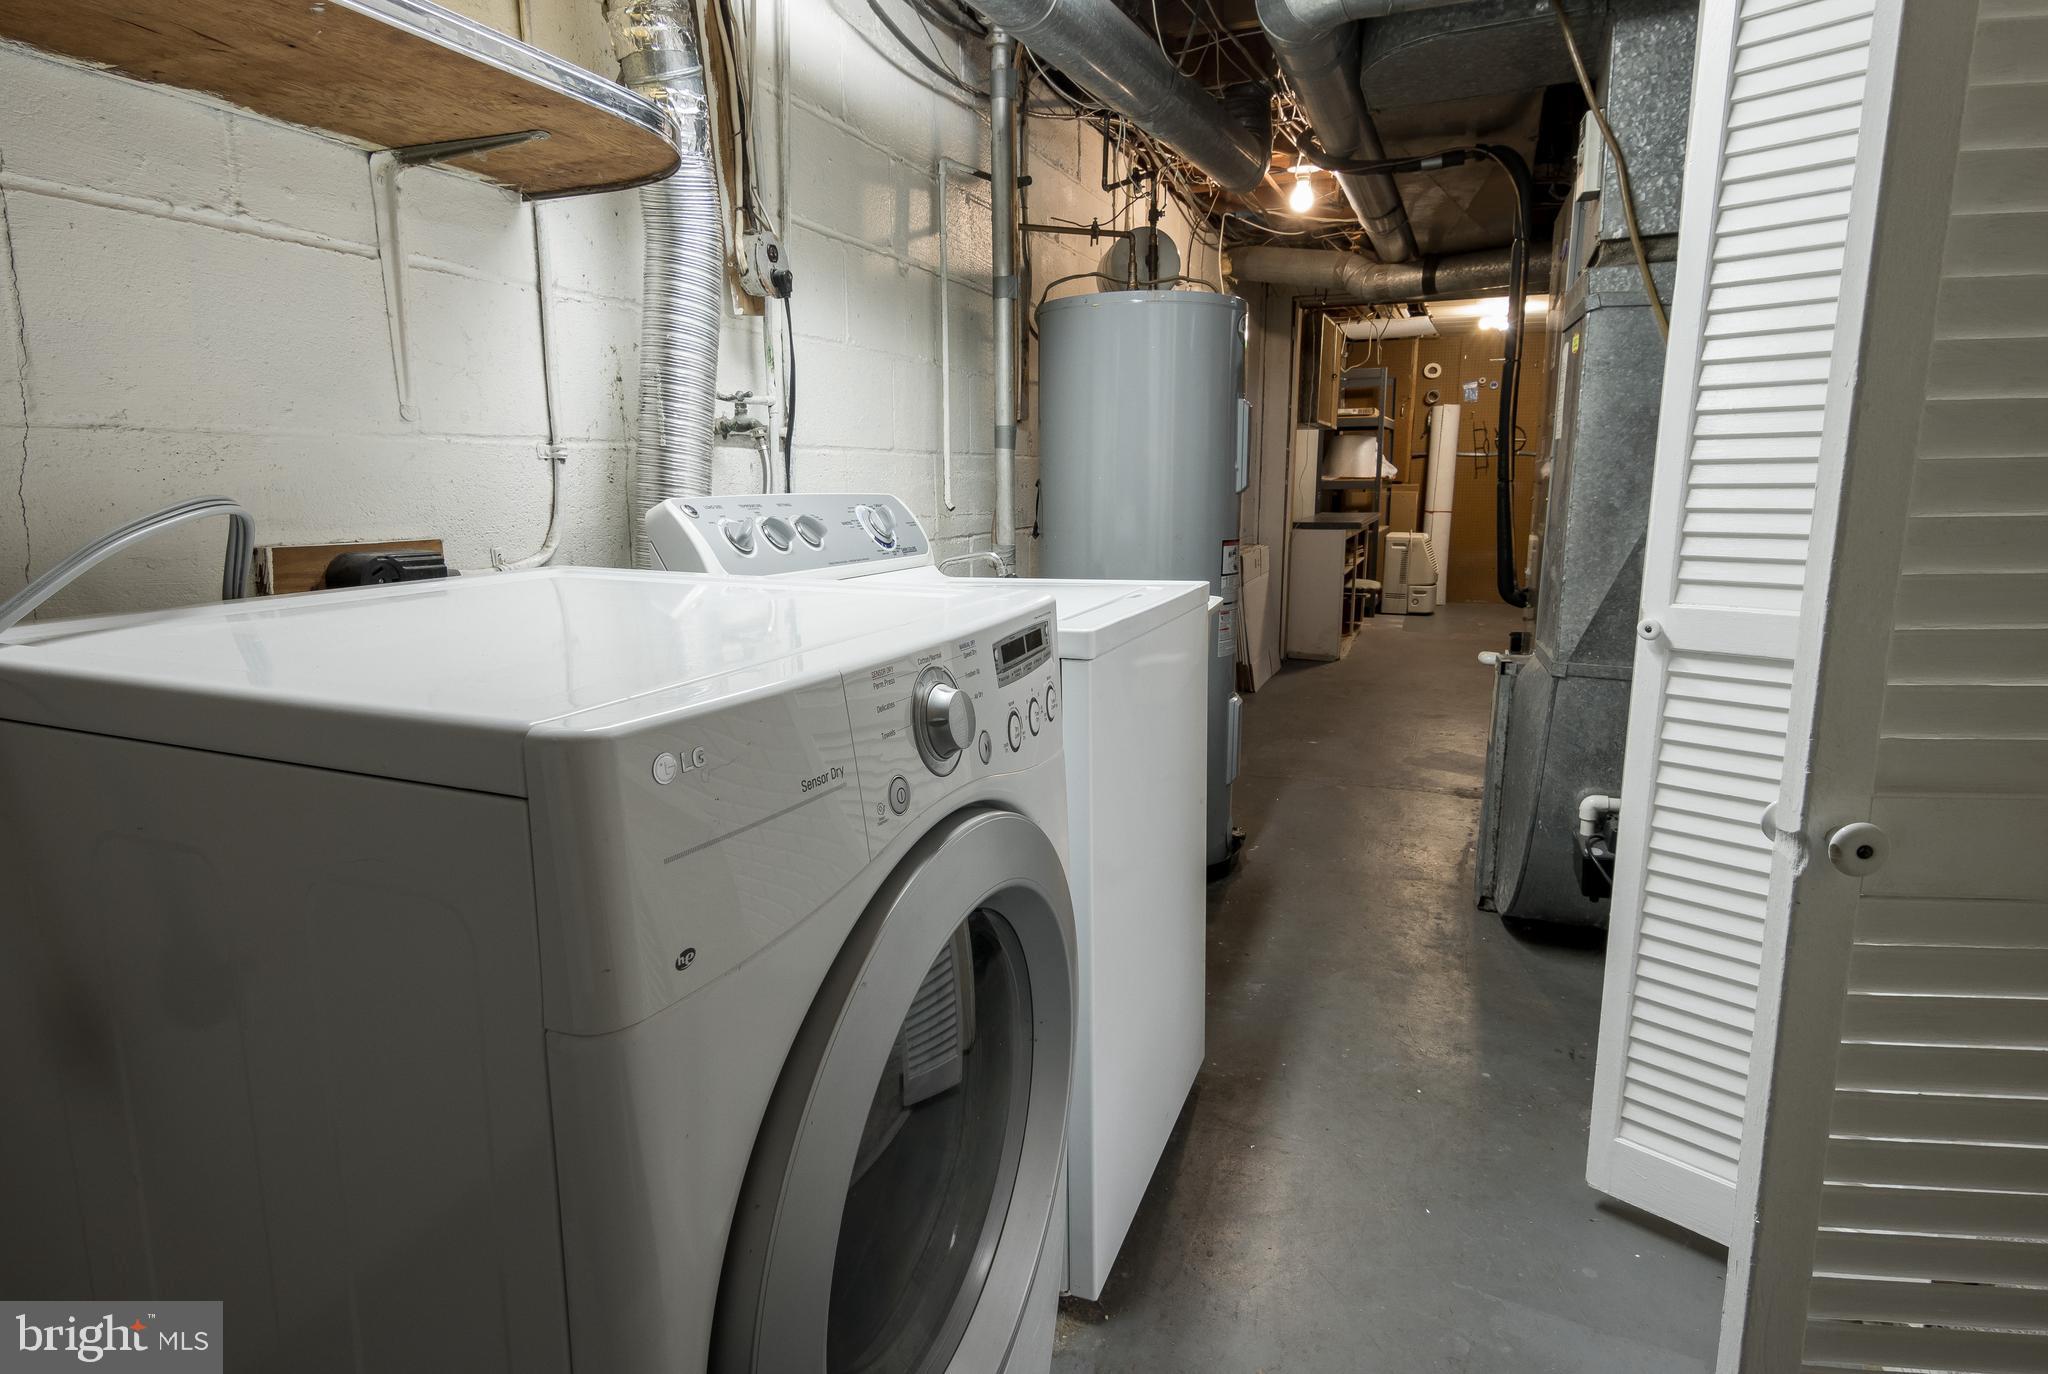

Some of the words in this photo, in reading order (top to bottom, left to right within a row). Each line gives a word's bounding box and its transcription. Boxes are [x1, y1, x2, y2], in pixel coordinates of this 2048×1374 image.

[876, 701, 896, 714] Delicates
[880, 729, 896, 740] Towels
[680, 745, 705, 774] LG
[800, 772, 829, 793] Sensor
[830, 766, 844, 780] Dry
